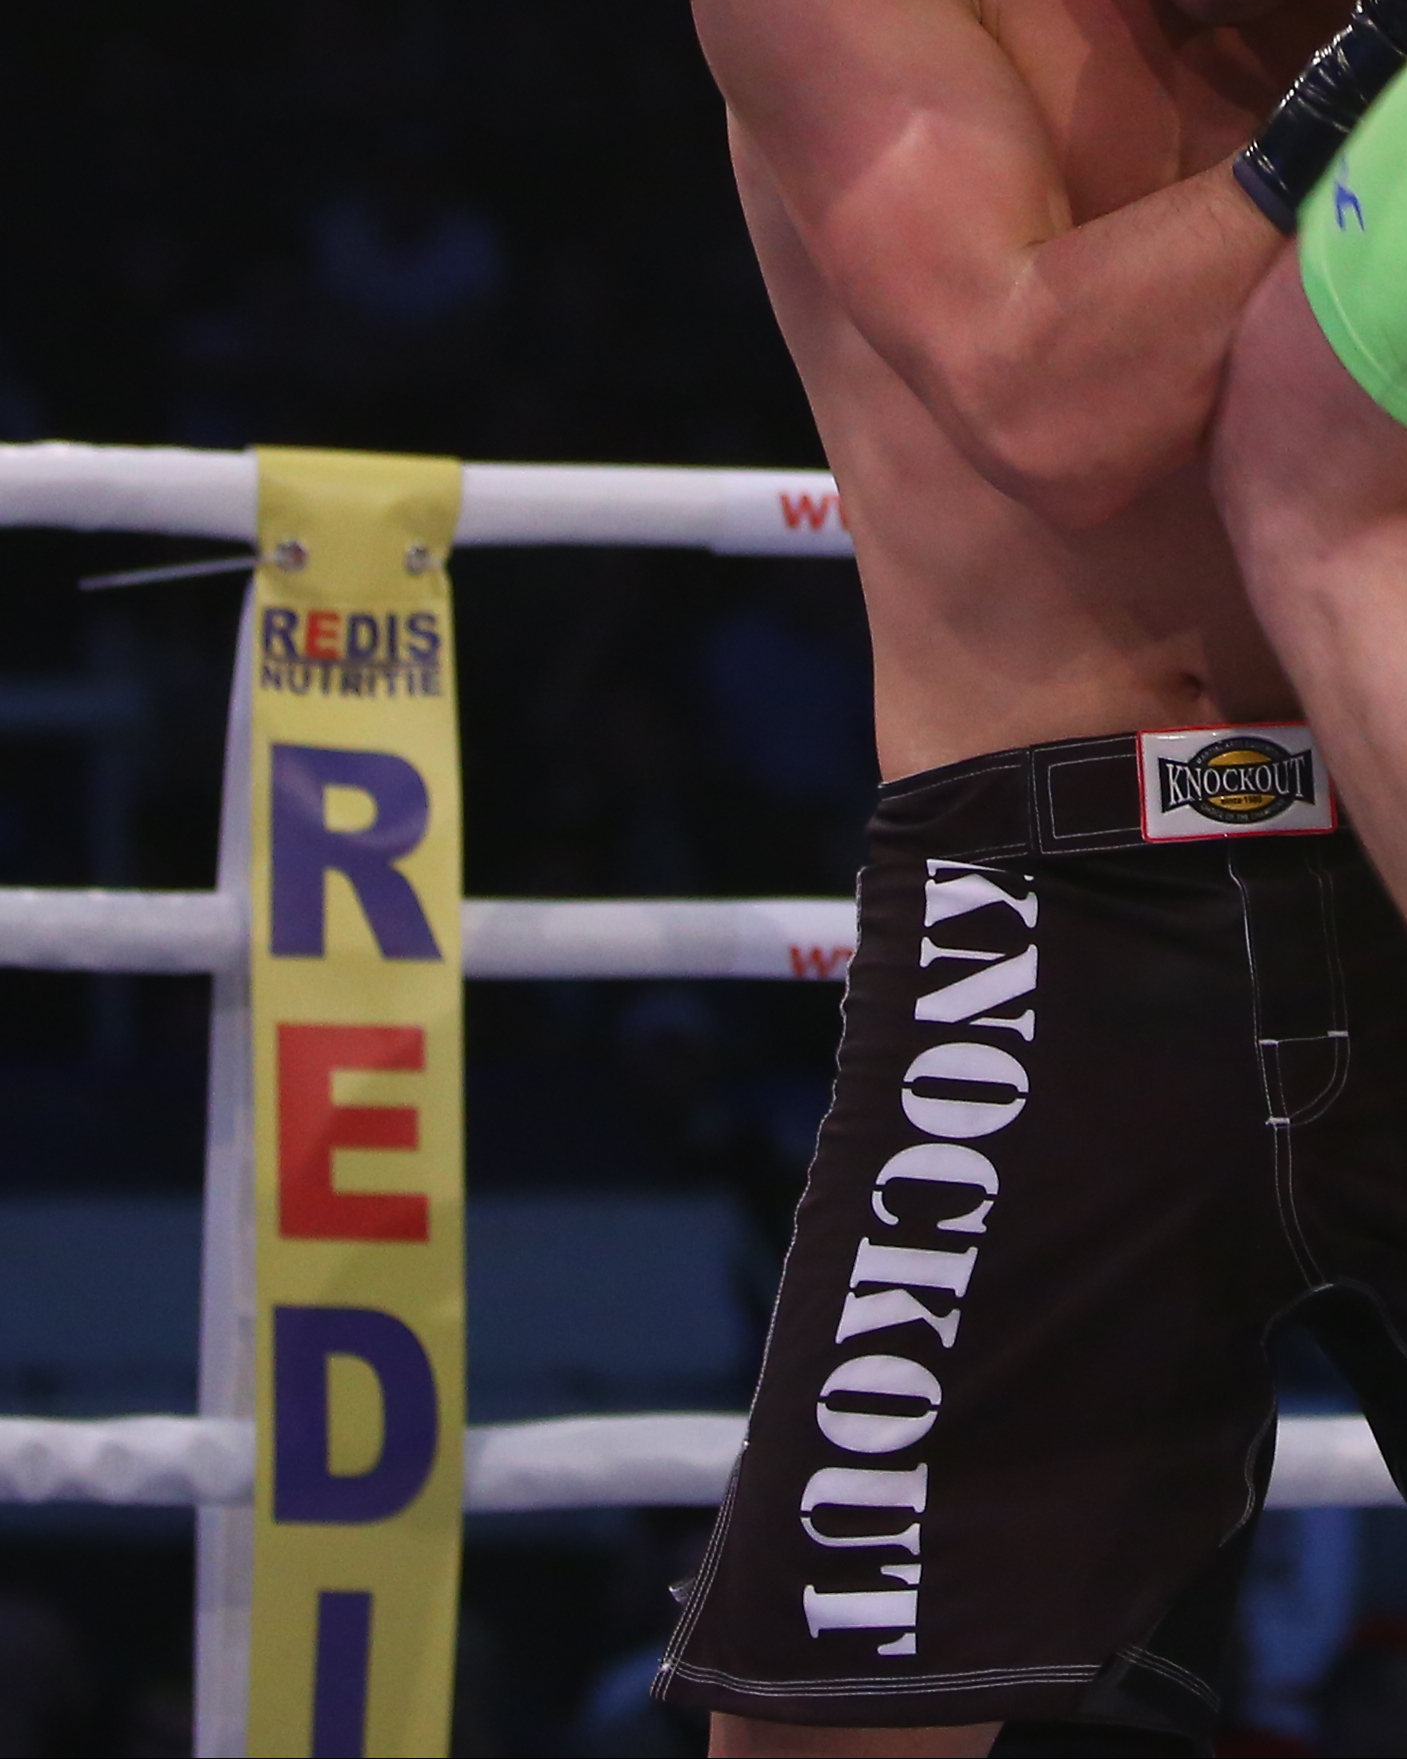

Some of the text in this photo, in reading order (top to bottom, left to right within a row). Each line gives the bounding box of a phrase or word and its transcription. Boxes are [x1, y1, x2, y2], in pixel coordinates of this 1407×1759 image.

[262, 608, 441, 662] REDIS
[1166, 756, 1306, 806] KNOCKOUT
[800, 858, 1040, 1656] KNOCKOUT
